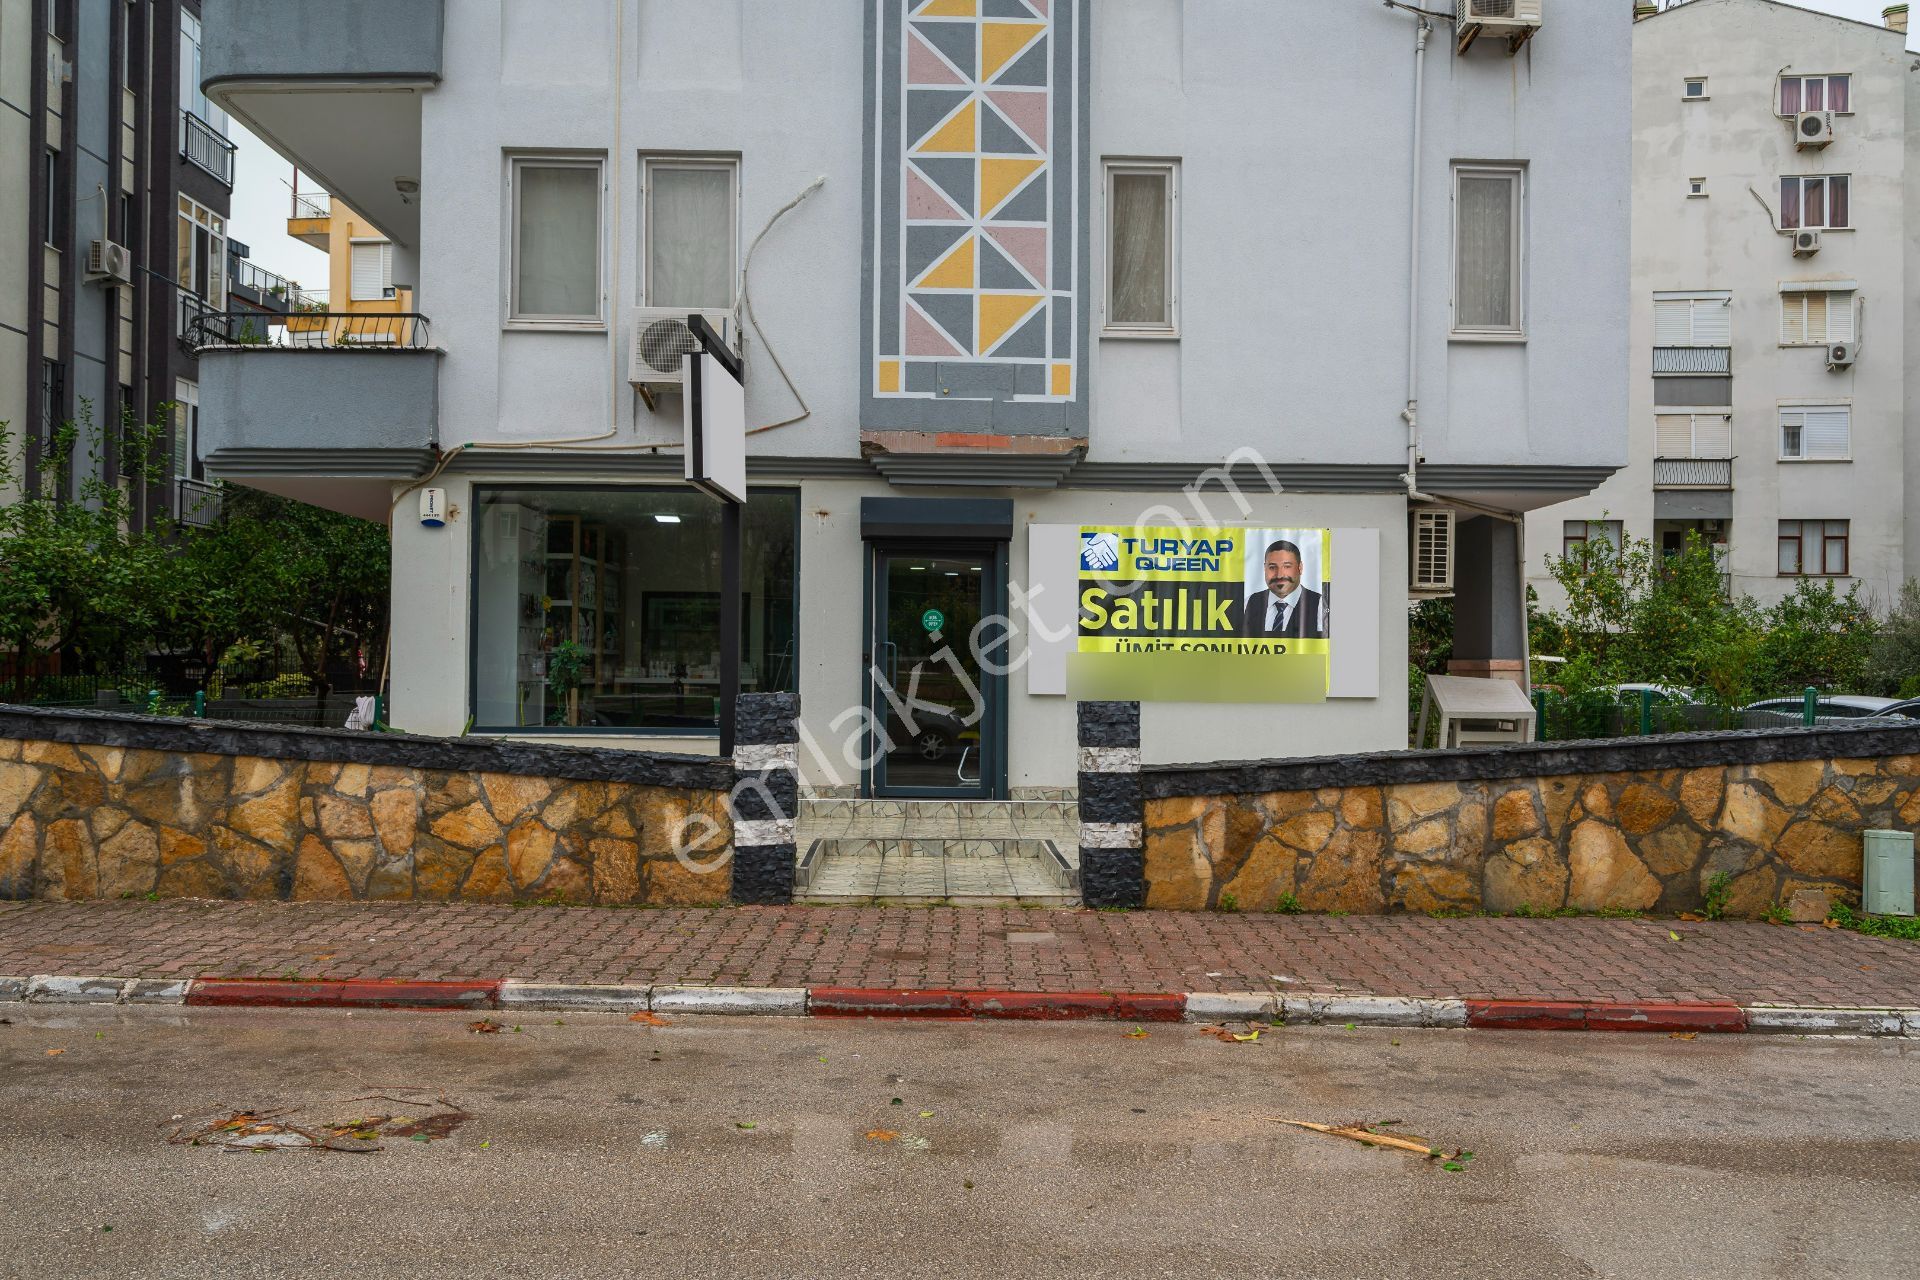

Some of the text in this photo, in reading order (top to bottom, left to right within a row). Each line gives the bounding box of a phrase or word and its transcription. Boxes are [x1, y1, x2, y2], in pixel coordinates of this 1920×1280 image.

[1122, 538, 1233, 556] TURYAP
[1135, 557, 1220, 572] QUEEN
[1079, 587, 1234, 631] Satılık
